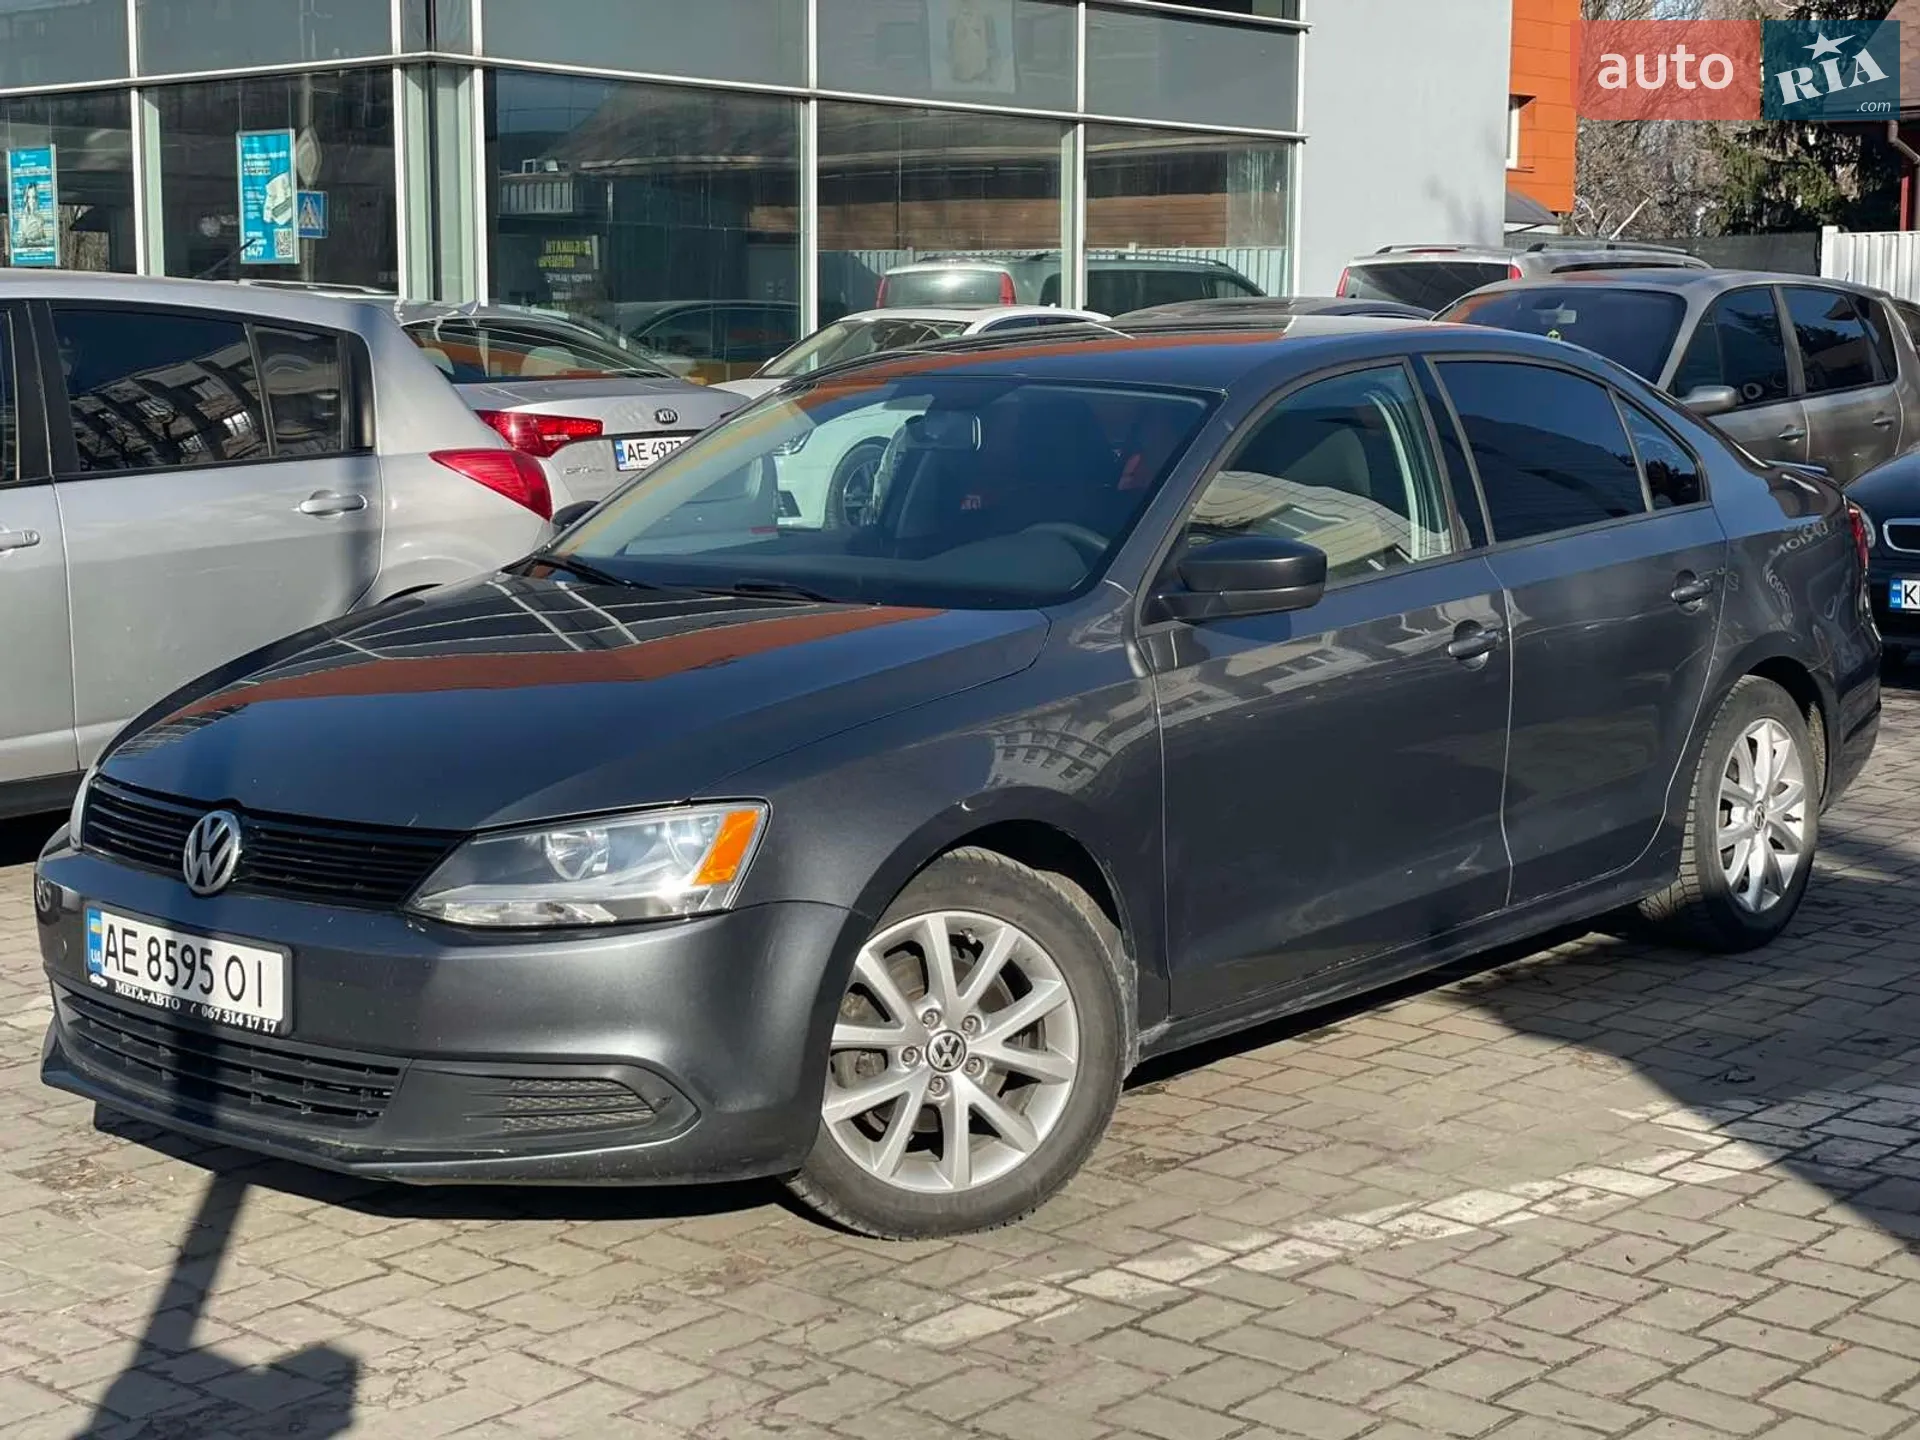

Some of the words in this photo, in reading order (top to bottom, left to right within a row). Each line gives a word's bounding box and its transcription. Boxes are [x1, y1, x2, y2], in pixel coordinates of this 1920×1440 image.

[658, 410, 677, 421] KIA
[627, 443, 648, 461] AE
[1904, 584, 1920, 605] K
[104, 923, 139, 977] AE
[147, 936, 214, 995] 8595
[115, 981, 181, 1010] МЕГА-АВТО
[201, 1006, 221, 1020] 067
[223, 1010, 244, 1027] 314
[246, 1014, 260, 1029] 17
[262, 1018, 277, 1034] 17
